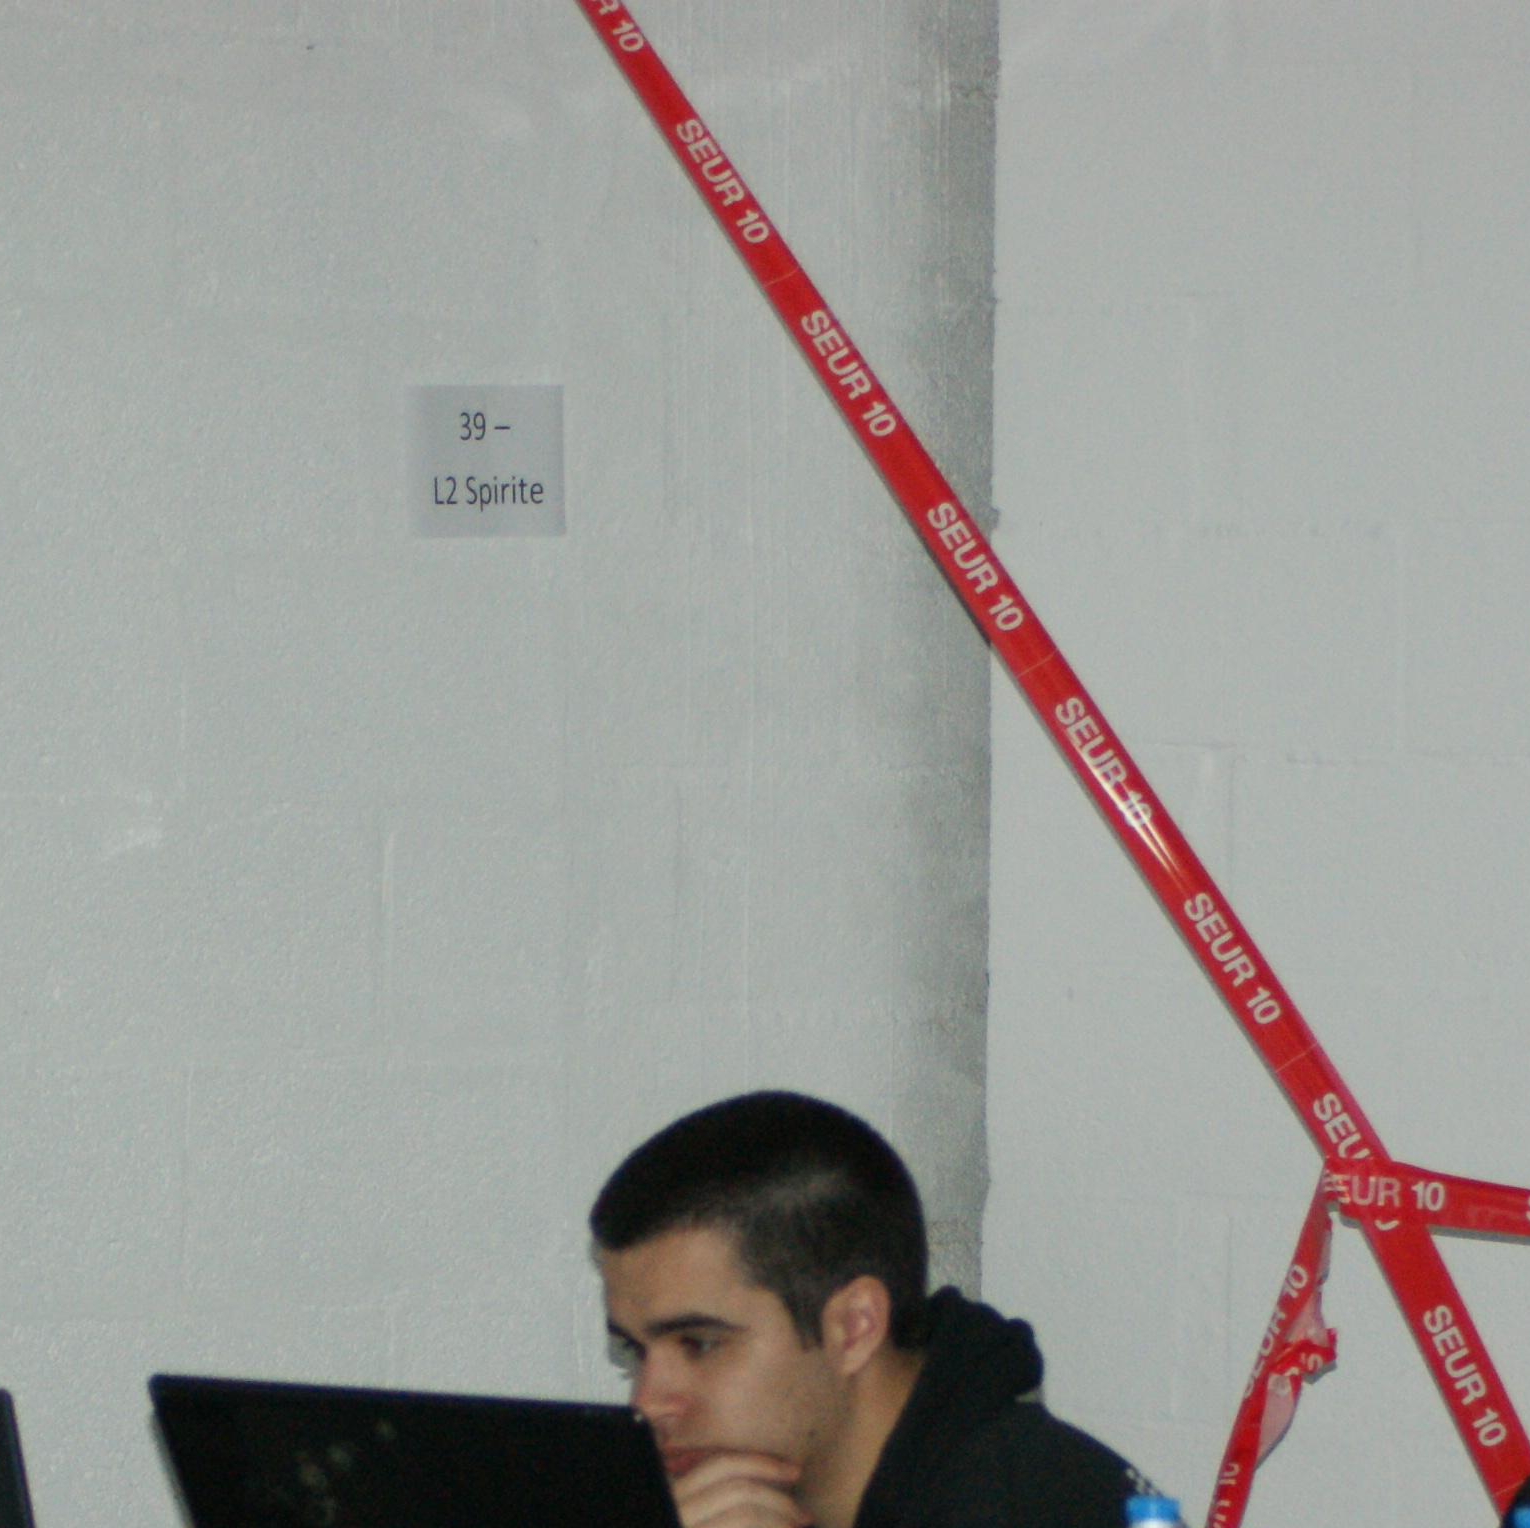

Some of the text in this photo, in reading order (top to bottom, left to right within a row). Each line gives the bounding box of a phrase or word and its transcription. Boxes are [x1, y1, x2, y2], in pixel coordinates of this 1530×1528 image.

[612, 20, 644, 52] 10
[676, 119, 769, 243] SEUR 10
[801, 310, 897, 437] SEUR 10
[460, 411, 487, 441] 39
[433, 475, 544, 512] L2 Spirite
[926, 502, 1025, 631] SEUR 10
[1055, 697, 1128, 788] SEUR
[1184, 892, 1281, 1026] SEUR 10
[1312, 1093, 1370, 1160] SEU
[1411, 1181, 1445, 1212] 10
[1422, 1304, 1508, 1447] SEUR 10
